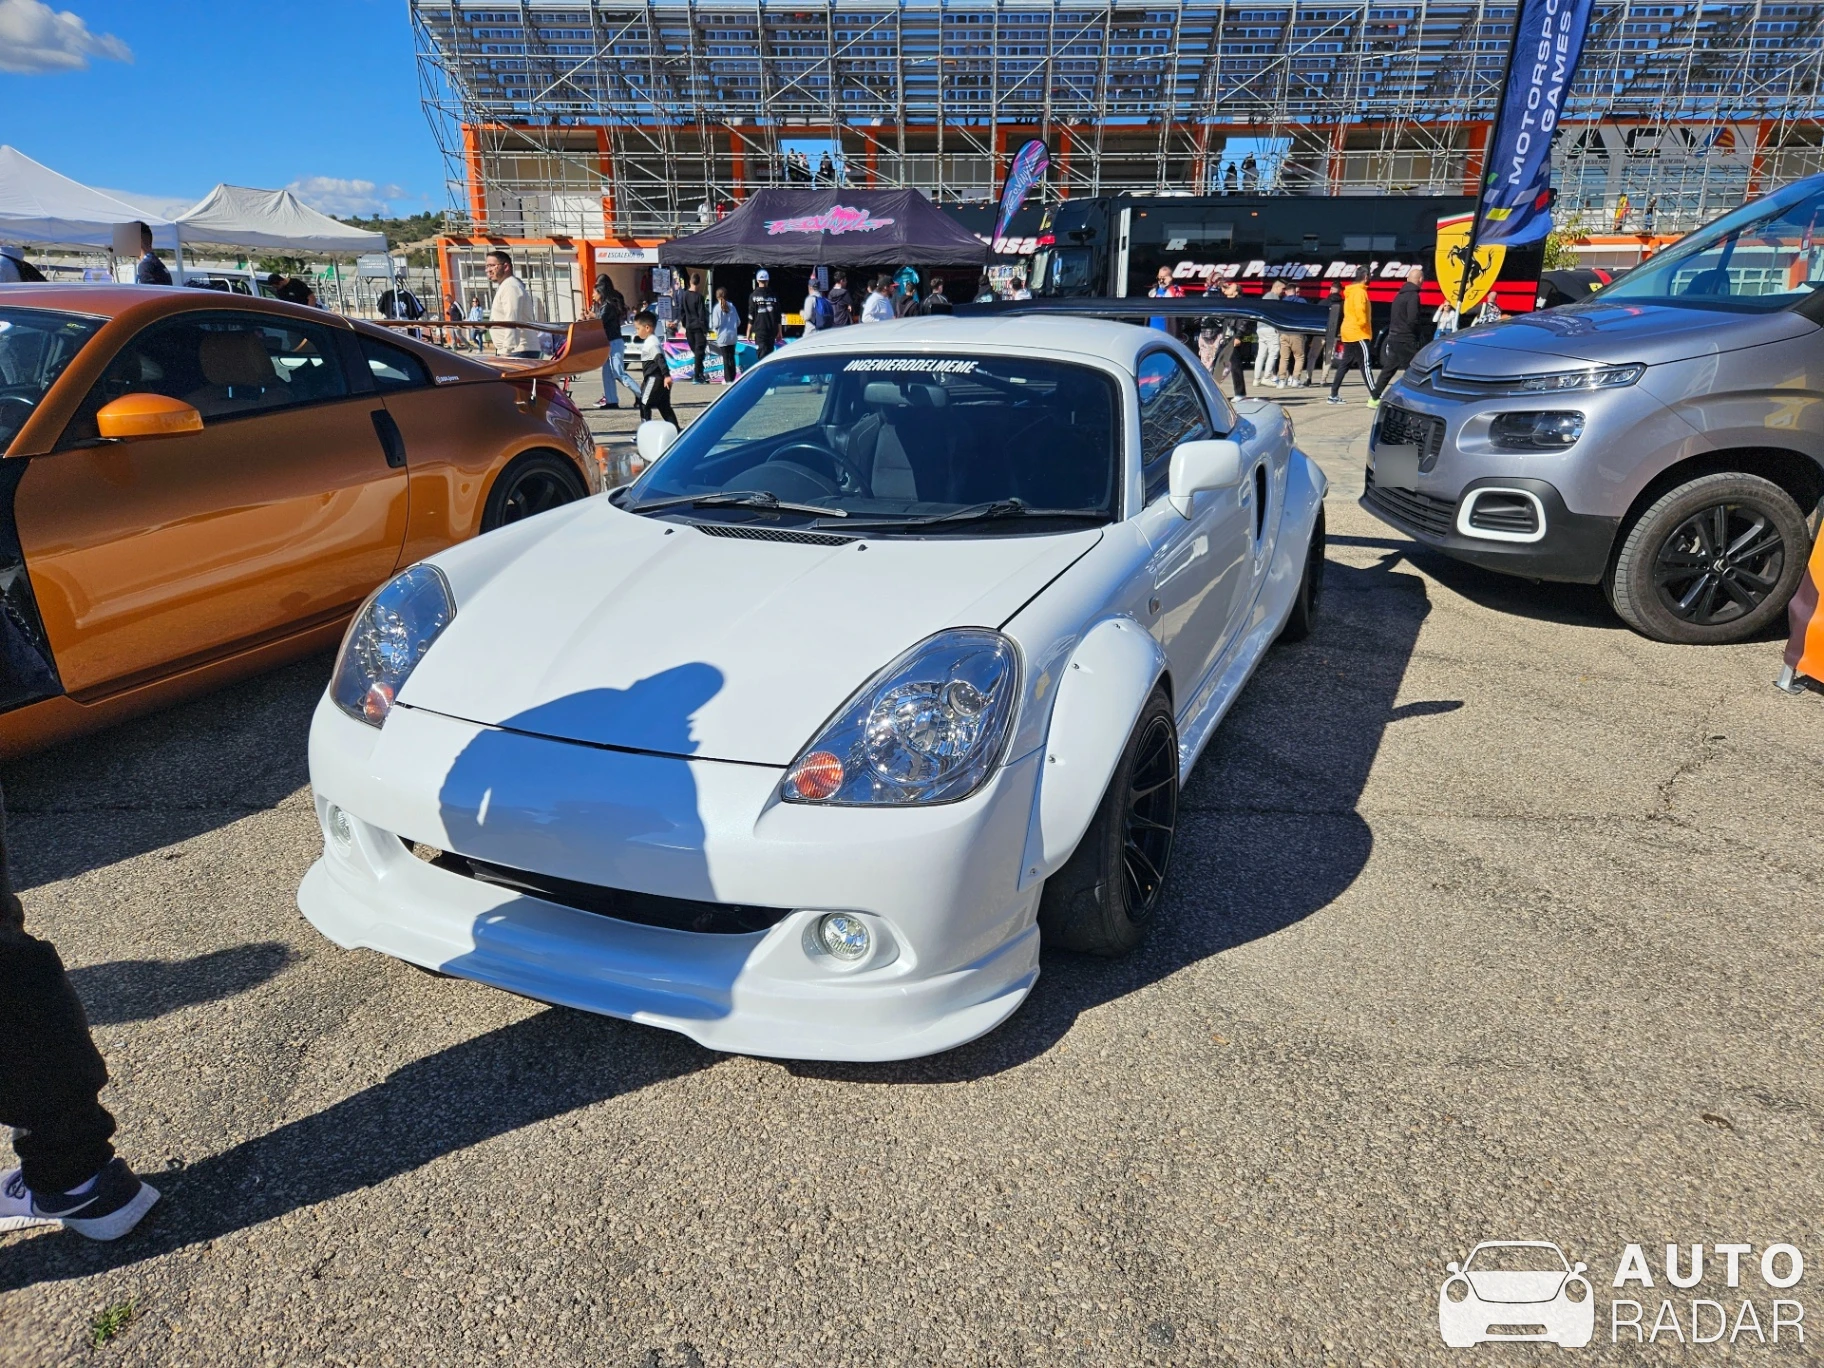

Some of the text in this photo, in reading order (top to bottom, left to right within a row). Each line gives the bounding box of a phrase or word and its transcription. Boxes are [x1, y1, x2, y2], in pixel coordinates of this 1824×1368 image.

[1541, 10, 1572, 133] GAMES
[1172, 261, 1241, 278] Crosa
[843, 359, 979, 374] INGENIERODELMEME
